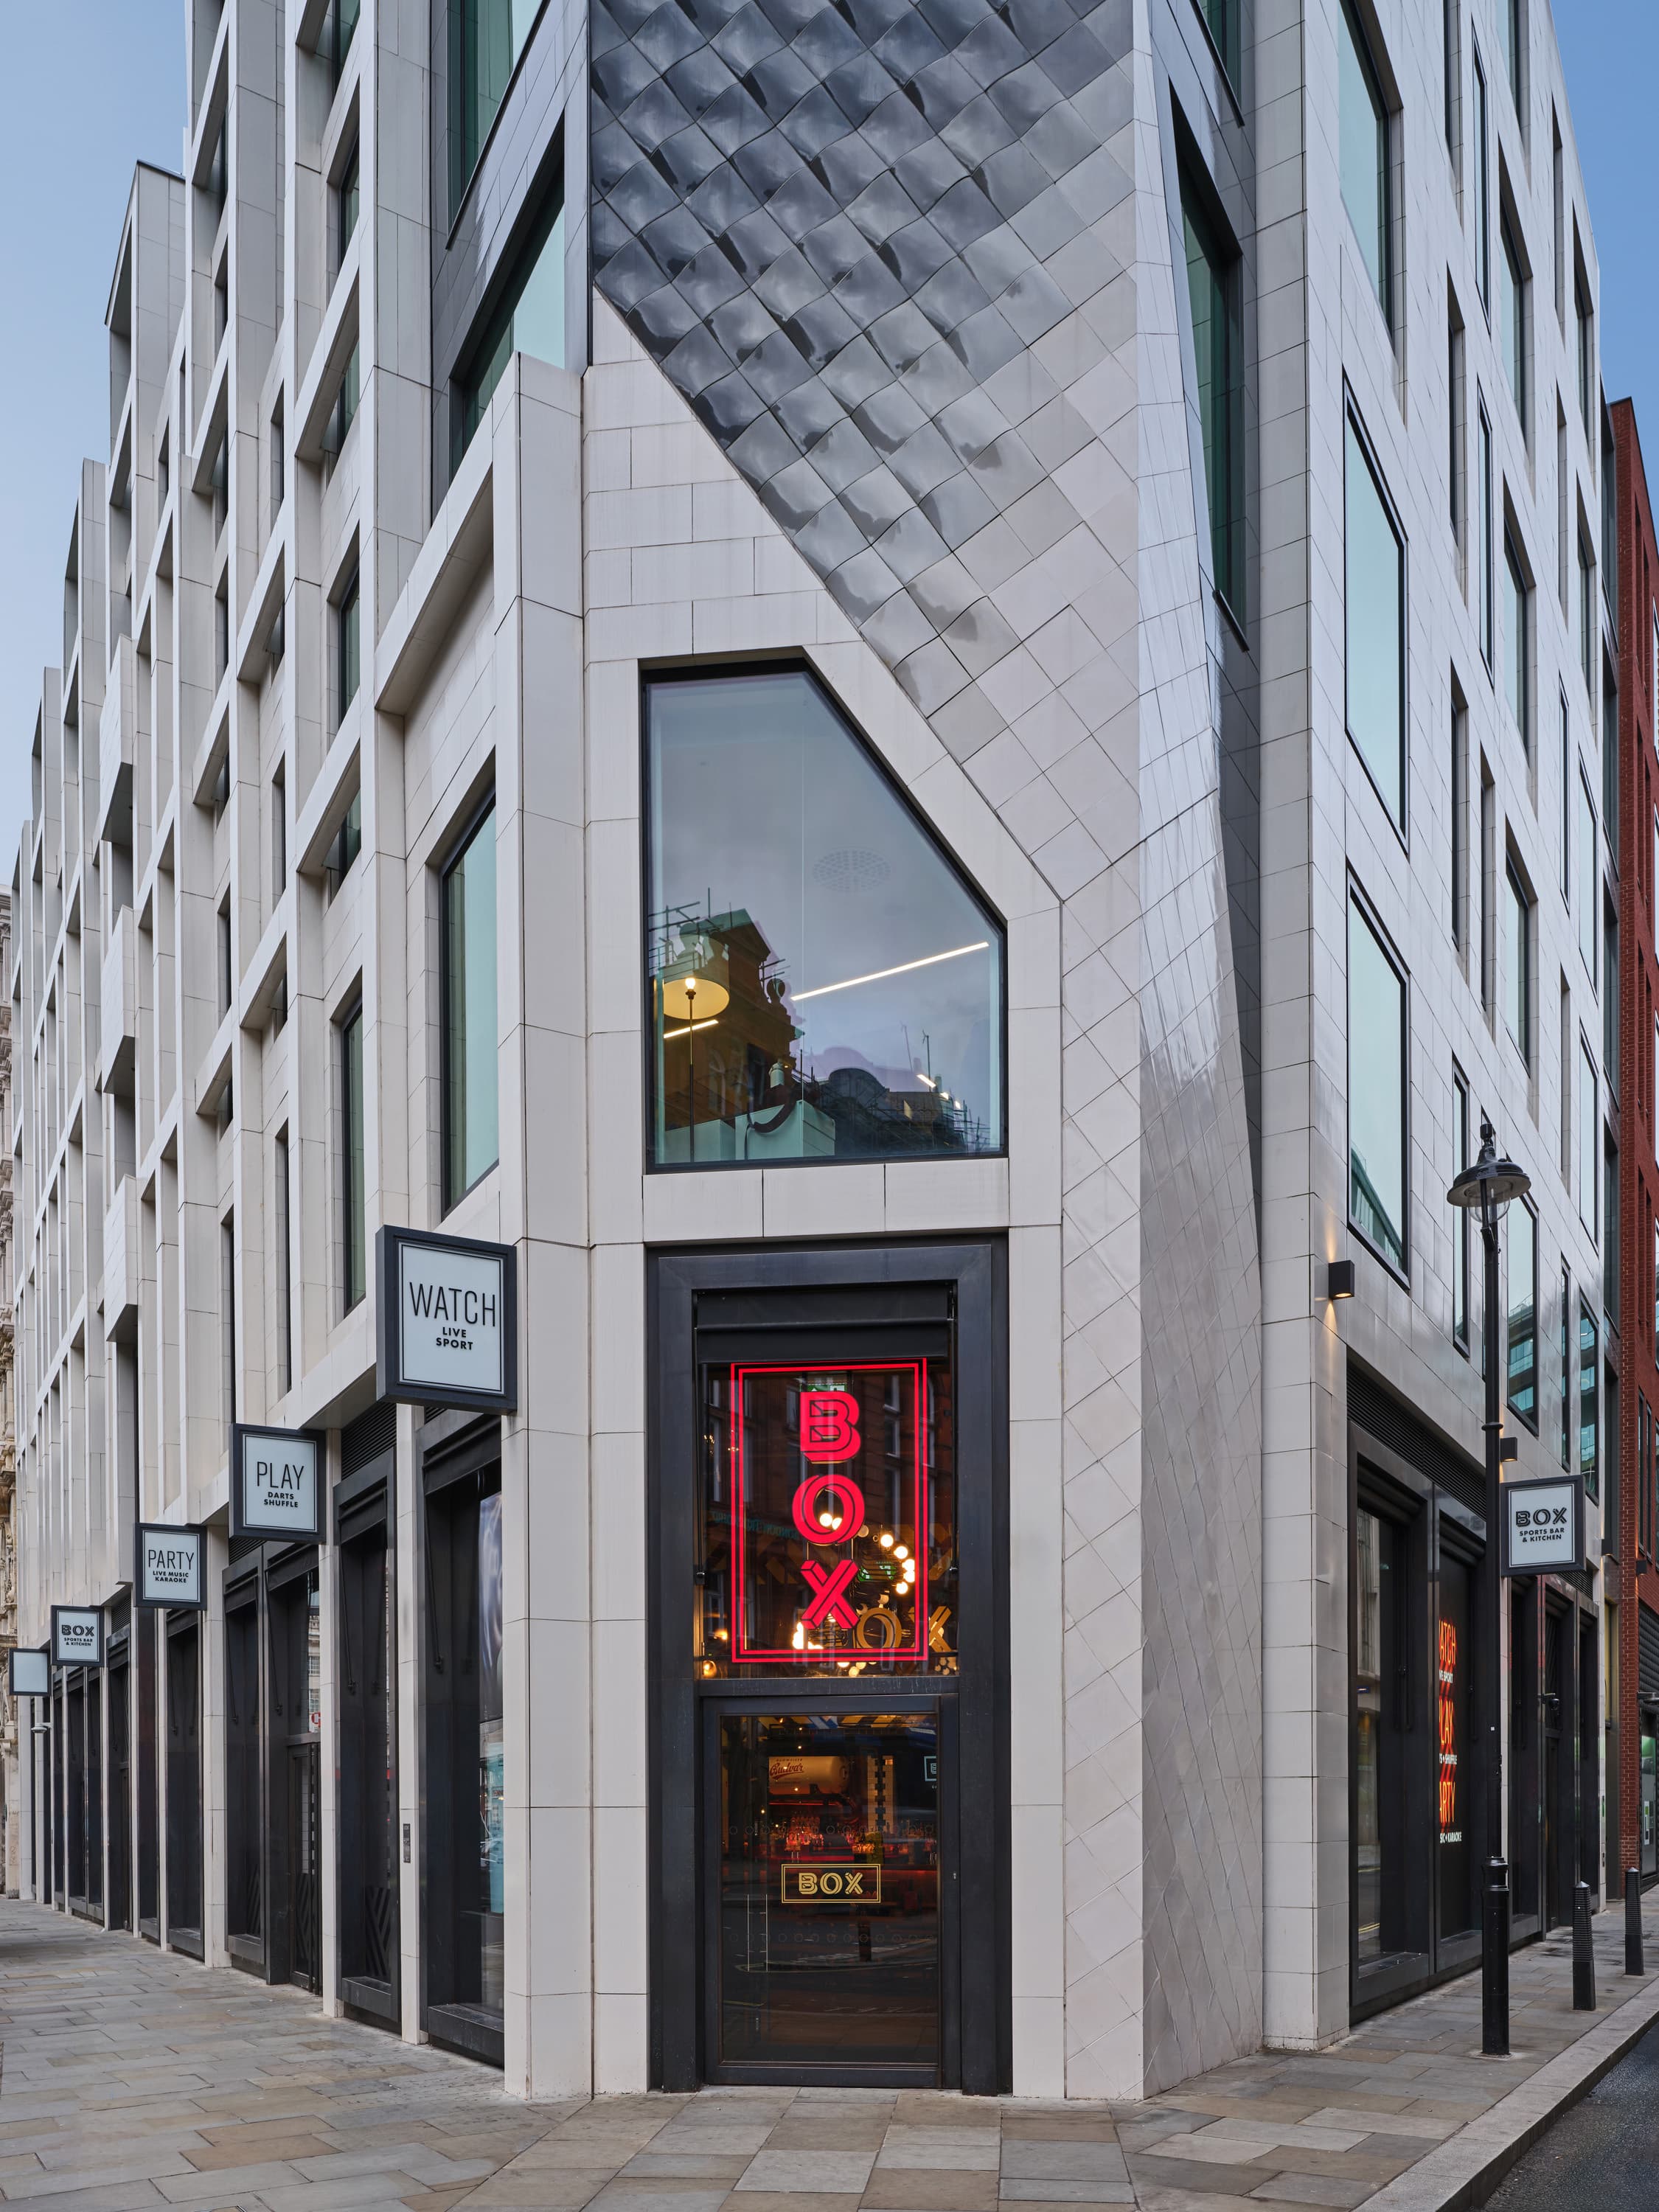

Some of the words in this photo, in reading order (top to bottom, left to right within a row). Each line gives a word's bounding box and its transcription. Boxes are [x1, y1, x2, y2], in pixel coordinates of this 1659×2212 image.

[409, 1281, 495, 1327] WATCH
[442, 1326, 467, 1338] LIVE
[436, 1338, 473, 1350] SPORT
[257, 1461, 305, 1490] PLAY
[268, 1492, 294, 1500] DARTS
[263, 1499, 299, 1508] SHUFFLE
[792, 1391, 865, 1630] BOX
[1516, 1507, 1567, 1527] BOX
[1520, 1528, 1548, 1537] SPORTS
[1530, 1534, 1562, 1543] KITCHEN
[148, 1549, 195, 1570] PARTY
[61, 1624, 94, 1637] BOX
[856, 1605, 952, 1652] OX
[1439, 1620, 1456, 1664] ATCH
[1443, 1671, 1453, 1683] SPORT
[1444, 1753, 1458, 1764] SHUFFLE
[1439, 1781, 1455, 1823] ARTY
[1447, 1832, 1462, 1843] KARAOKE
[799, 1872, 863, 1895] BOX
